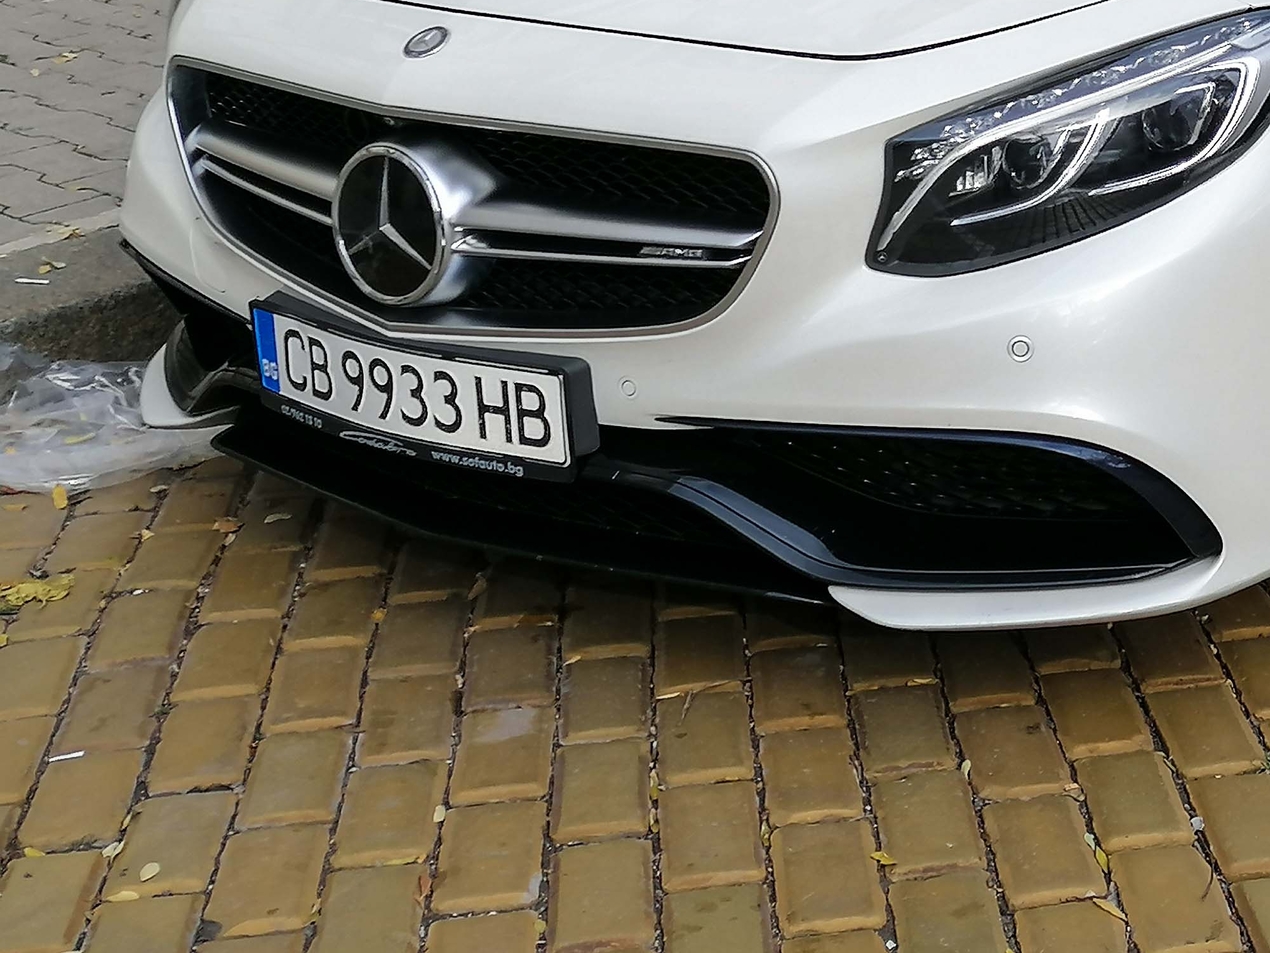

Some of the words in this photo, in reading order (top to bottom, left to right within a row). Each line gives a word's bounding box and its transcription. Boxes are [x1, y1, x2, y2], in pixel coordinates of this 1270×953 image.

[261, 358, 278, 381] BG
[283, 328, 333, 401] CB
[341, 350, 462, 434] 9933
[474, 375, 552, 448] HB
[431, 450, 525, 477] www.sofauto.bg
